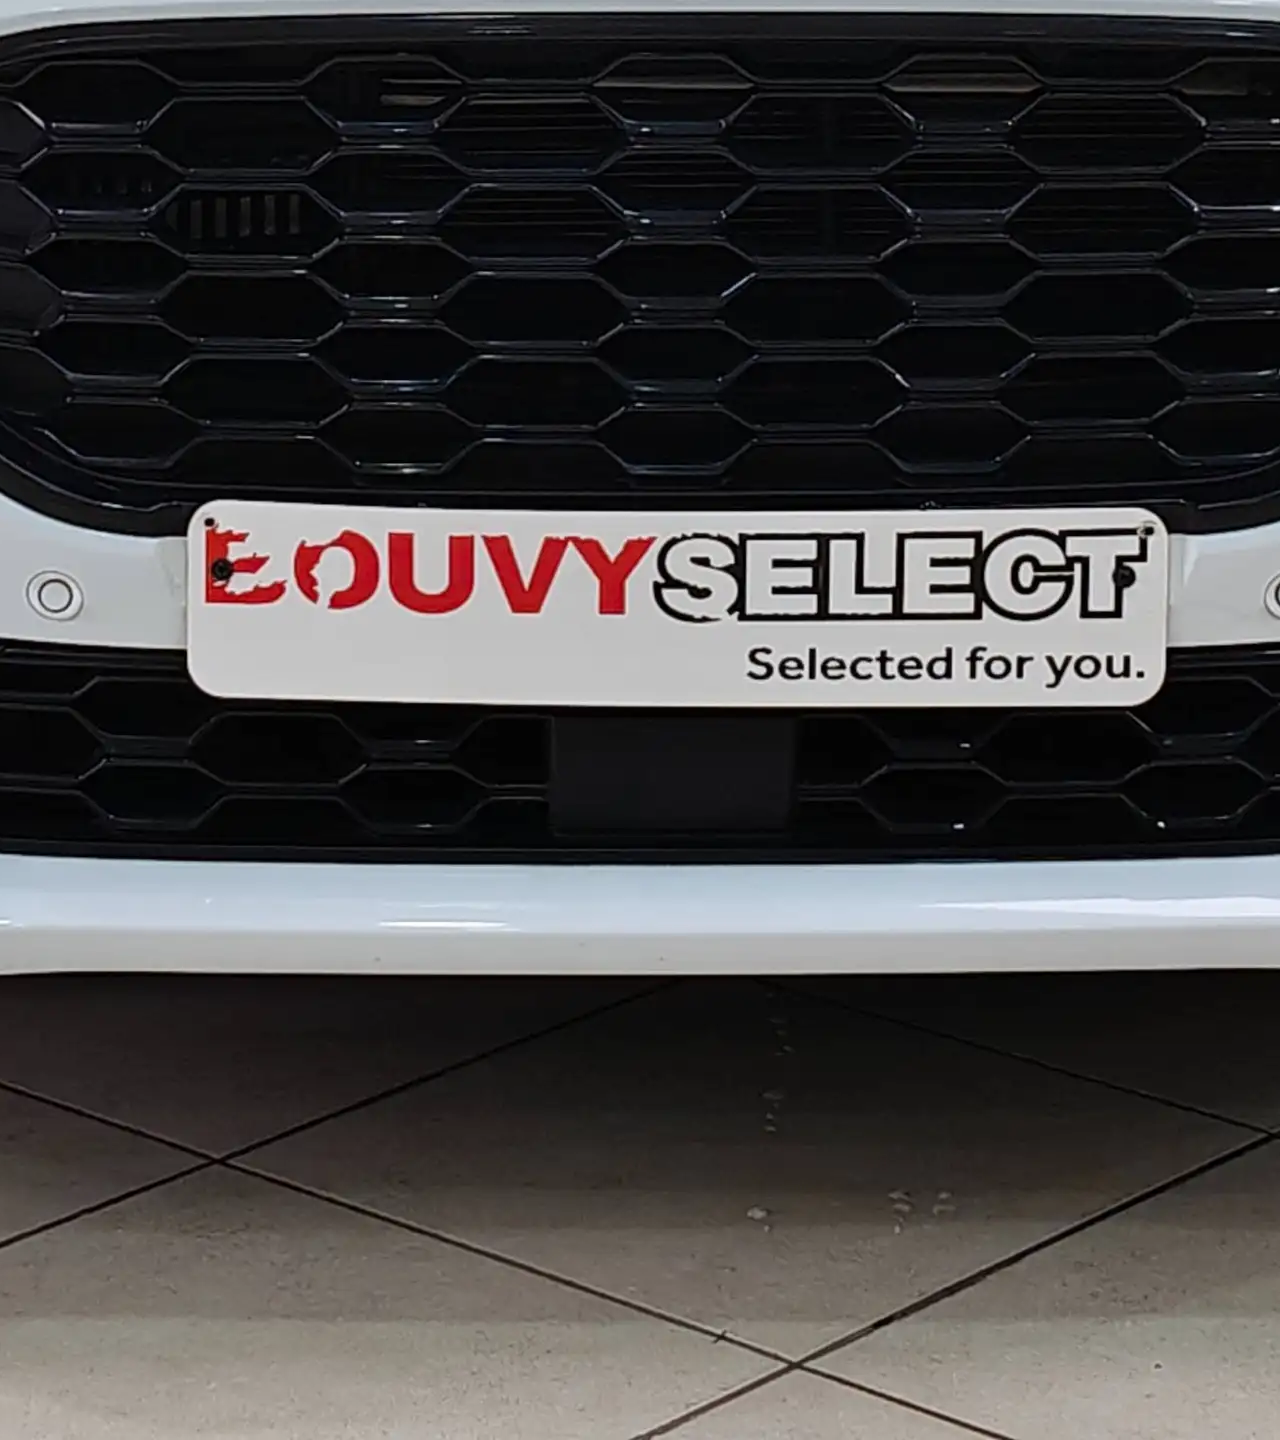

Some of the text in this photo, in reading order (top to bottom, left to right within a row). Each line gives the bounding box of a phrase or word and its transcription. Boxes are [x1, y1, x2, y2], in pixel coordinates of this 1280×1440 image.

[746, 646, 1145, 689] Selected for you.
